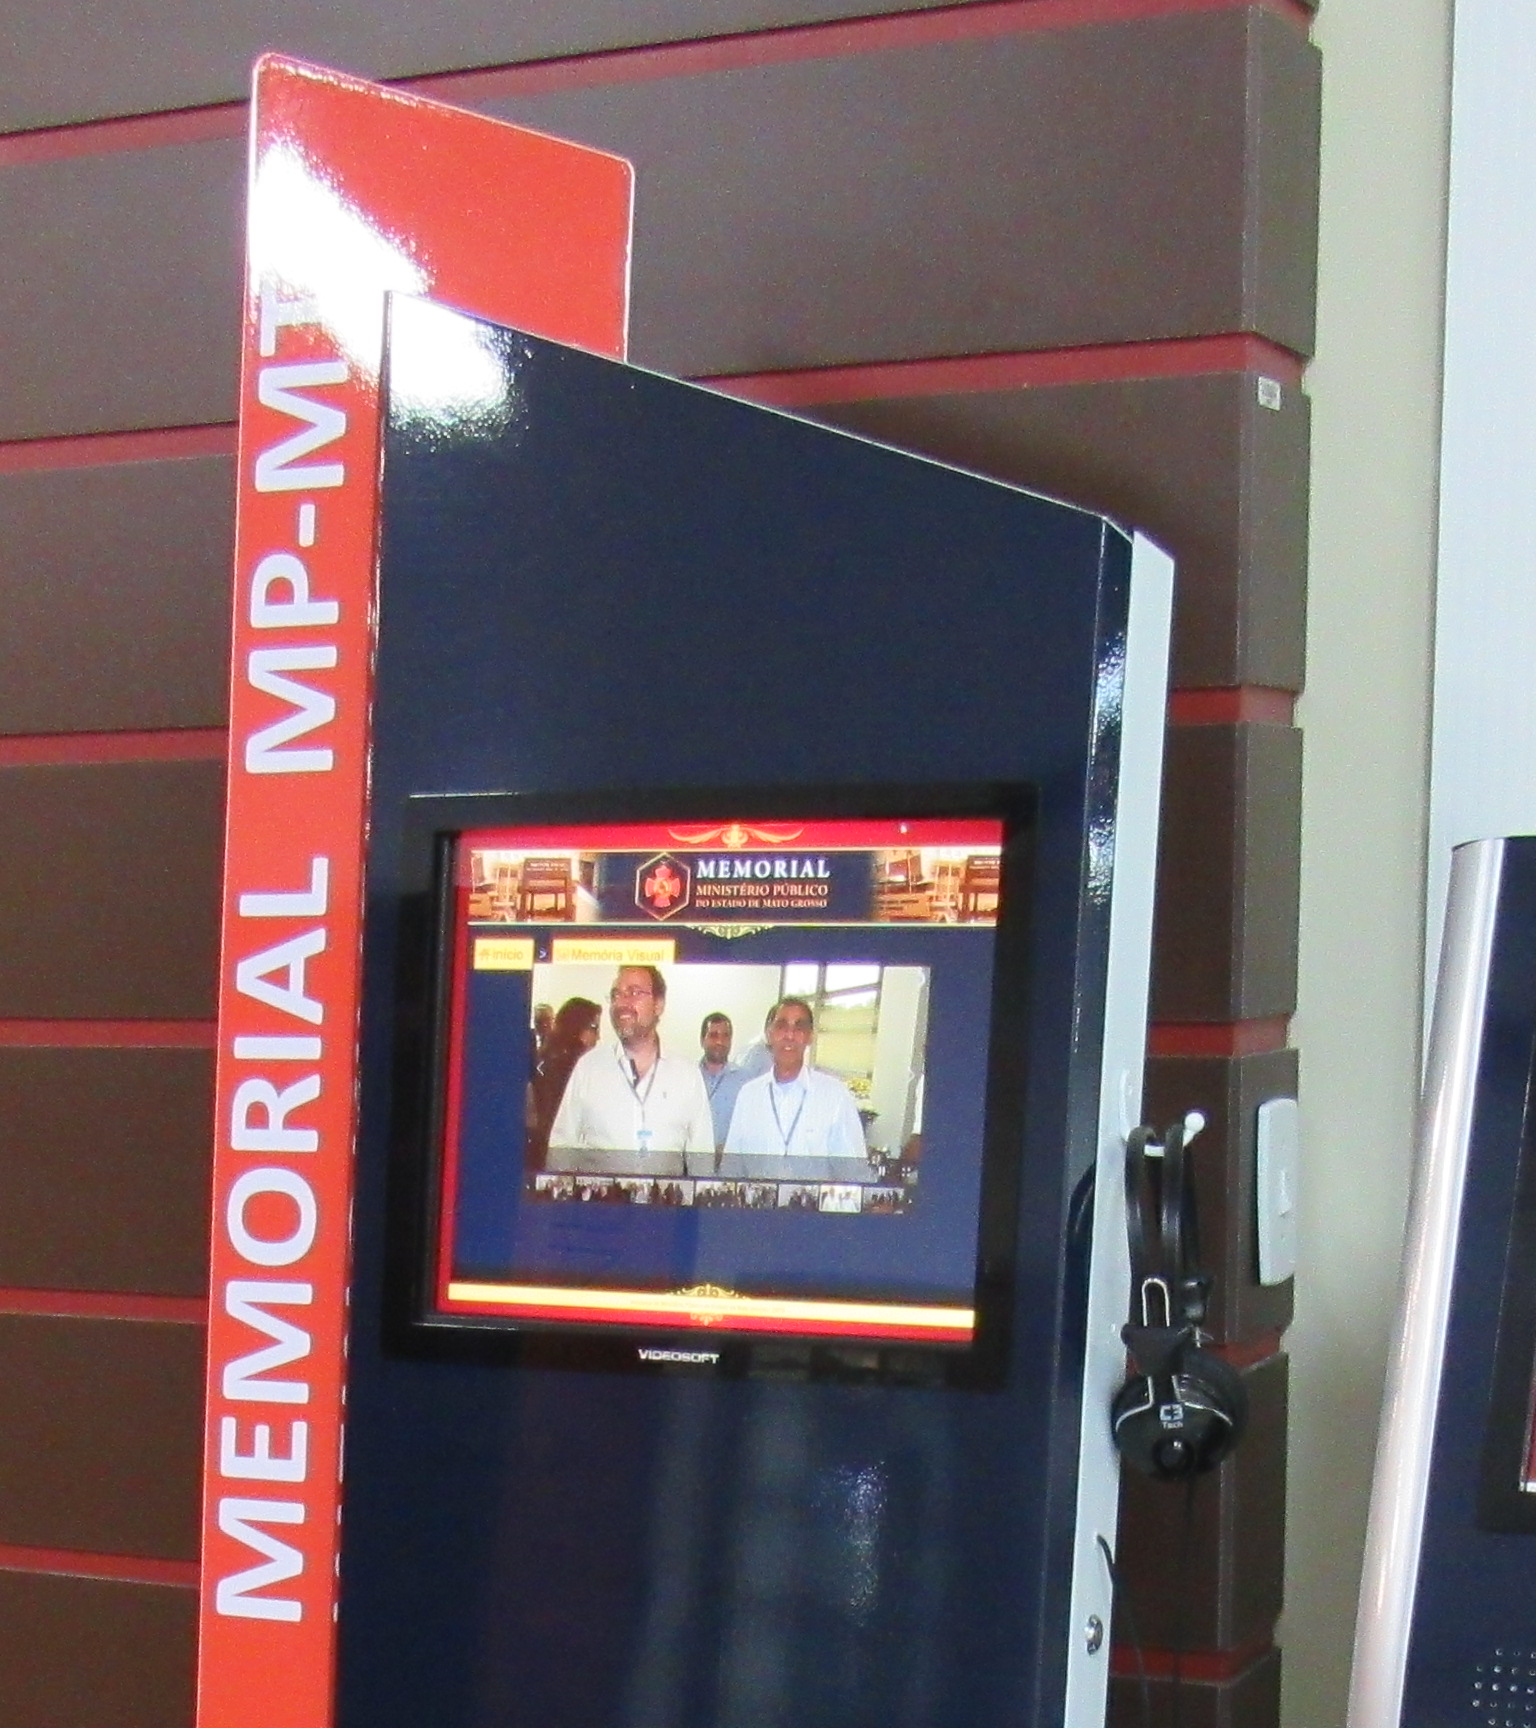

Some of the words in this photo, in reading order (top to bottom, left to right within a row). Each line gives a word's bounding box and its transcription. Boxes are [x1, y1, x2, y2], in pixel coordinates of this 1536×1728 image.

[245, 278, 349, 774] MP-MT
[696, 859, 831, 879] MEMORIAL
[695, 880, 770, 897] MINISTÉRIO
[772, 880, 829, 898] PÚBLICO
[571, 949, 623, 962] Memória
[627, 950, 664, 962] Visual
[216, 857, 330, 1623] MEMORIAL
[637, 1348, 720, 1365] VIDEOSOFT
